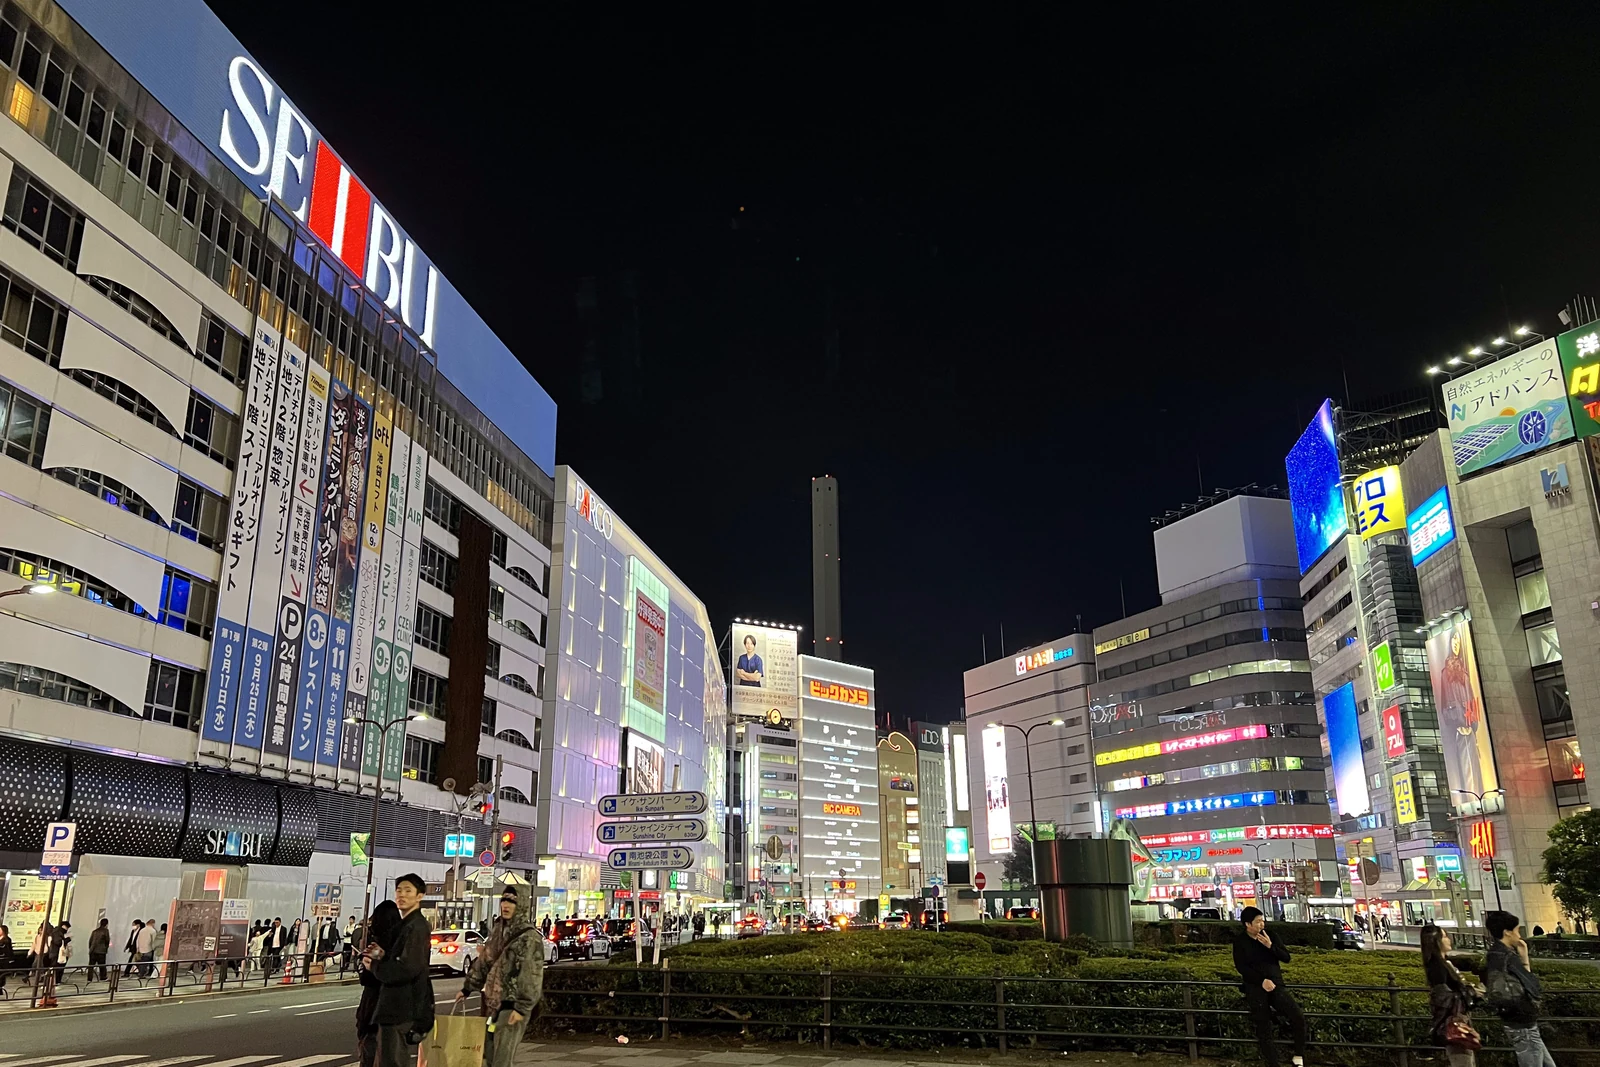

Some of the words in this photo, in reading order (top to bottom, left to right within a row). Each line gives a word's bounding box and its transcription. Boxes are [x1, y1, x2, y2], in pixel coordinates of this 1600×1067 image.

[219, 55, 438, 350] SEIBU
[257, 328, 278, 352] SEIBU
[284, 349, 305, 372] SEIBU
[246, 344, 266, 427] 地下1階
[310, 375, 325, 391] Times
[1446, 348, 1553, 402] 自然エネルギーの
[1471, 367, 1559, 414] アドバンス
[274, 364, 294, 444] 地下2階
[245, 409, 270, 542] リニューアルオープン
[273, 427, 297, 555] リニューアルオープン
[1545, 487, 1571, 500] HULIC
[315, 407, 348, 608] ダイニングパーク池袋
[407, 507, 421, 527] AIR
[576, 480, 613, 540] PARCO
[378, 562, 391, 632] ラビータ
[285, 606, 298, 636] P
[308, 617, 325, 647] 8F
[354, 583, 370, 662] Yodobloom
[221, 627, 241, 643] 第1弾
[251, 637, 269, 652] 第2弾
[375, 645, 389, 670] 9F
[395, 654, 408, 677] 9F
[213, 644, 232, 732] 9月17日(水)
[355, 666, 364, 687] 1F
[272, 642, 297, 746] 24時間営業
[298, 651, 320, 751] レストラン
[323, 626, 346, 757] 朝11時から営業
[809, 680, 869, 706] ビックカメラ
[1387, 734, 1403, 750] アコム
[1251, 793, 1265, 803] 4F
[1395, 778, 1409, 797] プロ
[620, 795, 681, 807] イケ・サンパーク
[645, 804, 665, 812] Sunpark
[823, 803, 835, 814] BIC
[835, 804, 861, 816] CAMERA
[1399, 798, 1413, 816] ミス
[50, 826, 70, 848] P
[618, 823, 682, 834] サンシャインシティ
[656, 832, 666, 840] City
[1470, 821, 1494, 859] H&M
[205, 829, 263, 858] SEIBU
[628, 850, 669, 860] 南池袋公園
